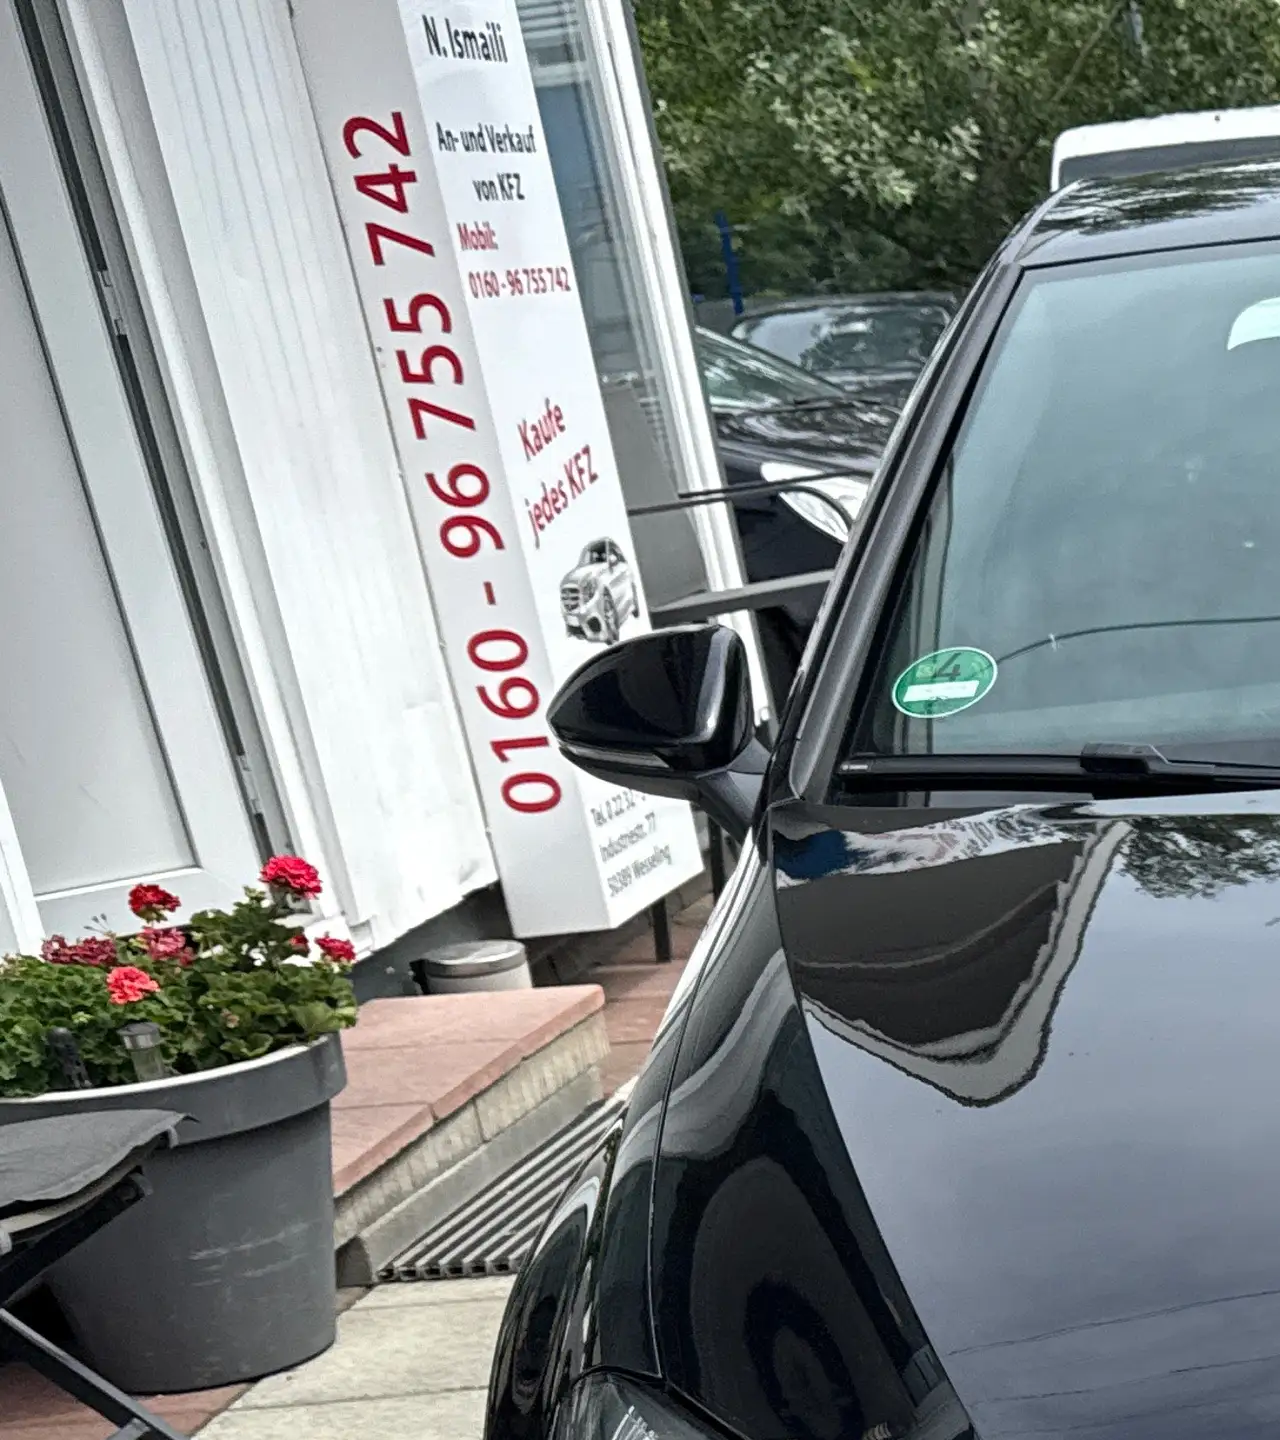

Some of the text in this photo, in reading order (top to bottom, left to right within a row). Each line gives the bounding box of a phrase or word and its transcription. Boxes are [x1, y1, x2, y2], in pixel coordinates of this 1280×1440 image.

[422, 14, 508, 63] N. Ismaili
[436, 121, 537, 153] An- und Verkauf
[343, 111, 435, 266] 742
[472, 172, 525, 201] von KFZ
[456, 221, 499, 251] Mobil:
[468, 271, 500, 299] 0160
[506, 269, 523, 296] 96
[522, 268, 547, 294] 755
[546, 267, 571, 292] 742
[383, 293, 476, 440] 755
[517, 397, 566, 462] Kaufe
[425, 463, 505, 558] 96
[524, 444, 599, 549] jedes KFZ
[915, 652, 961, 681] 4
[467, 629, 562, 813] 0160
